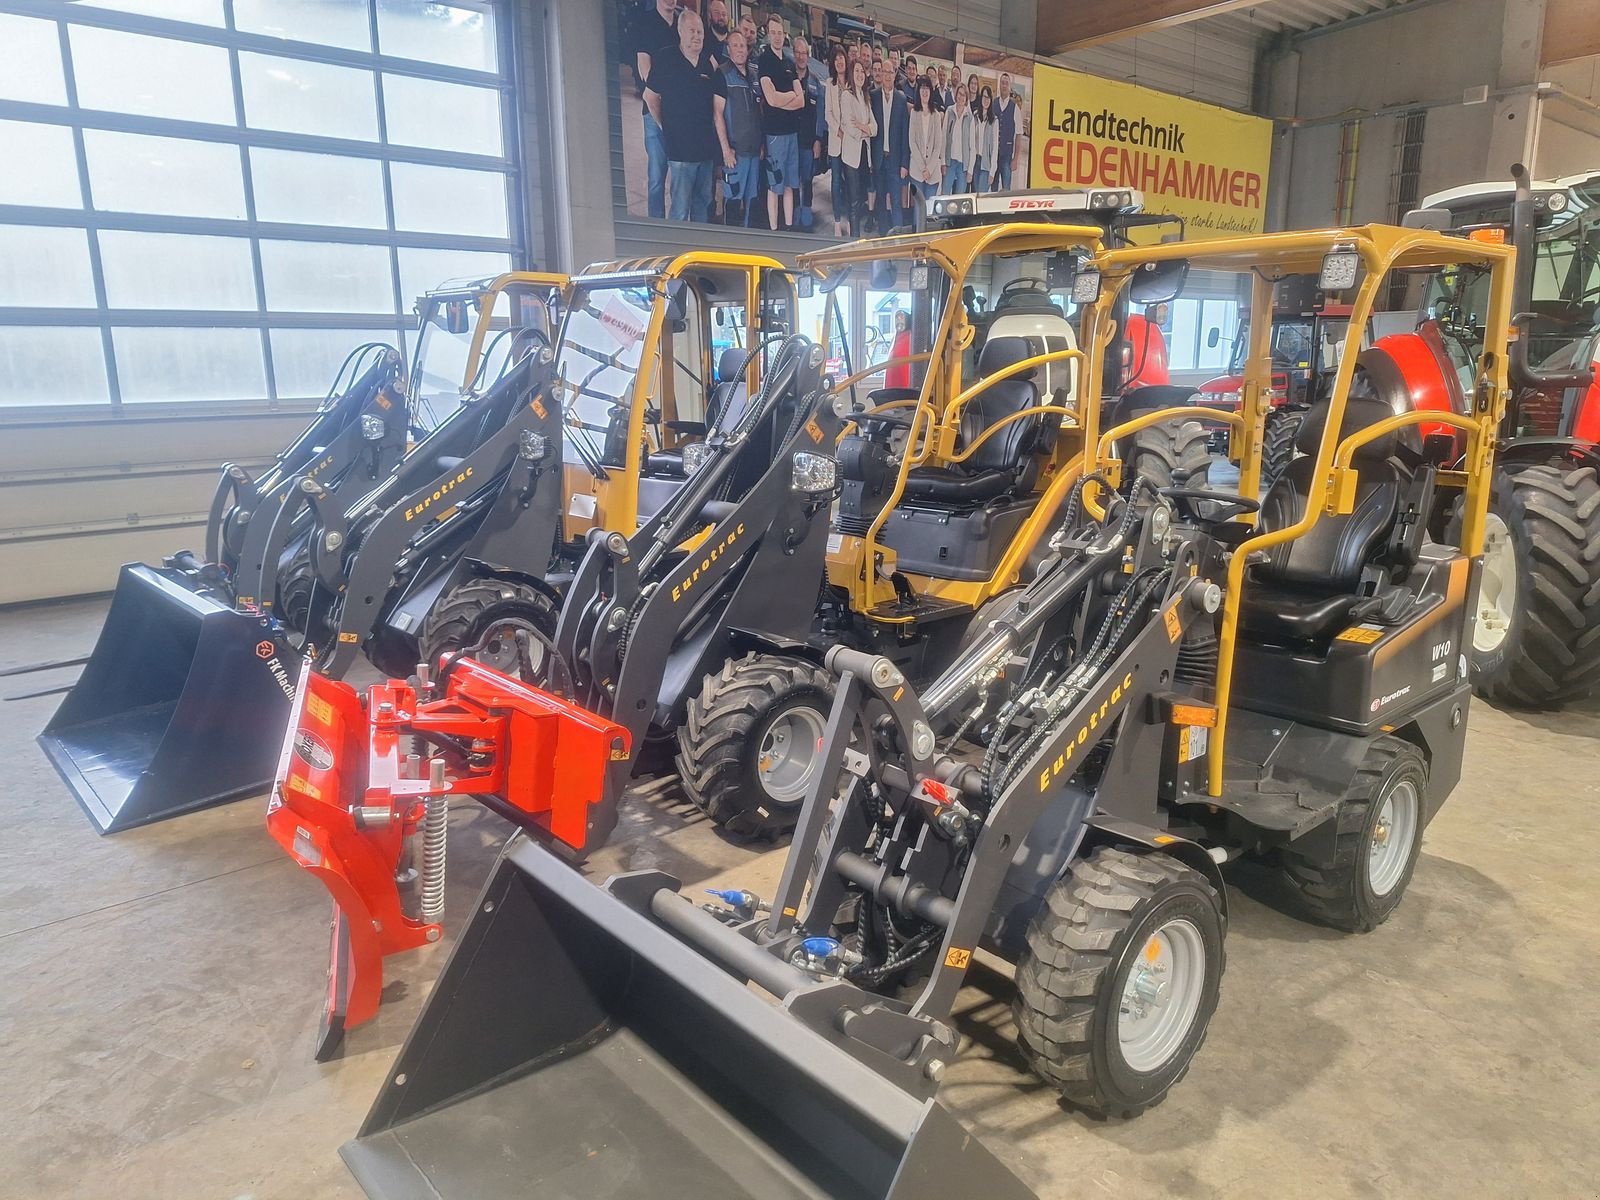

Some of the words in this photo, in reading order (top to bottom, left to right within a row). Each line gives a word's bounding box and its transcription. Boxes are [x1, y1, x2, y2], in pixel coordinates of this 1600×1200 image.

[1048, 99, 1185, 153] Landtechnik
[1043, 138, 1261, 209] EIDENHAMMER
[1009, 199, 1056, 209] STEYR
[404, 465, 475, 522] Eurotrac
[671, 521, 746, 602] Eurotrac
[267, 657, 282, 673] FK
[1432, 640, 1451, 662] W10
[1381, 685, 1411, 706] Eurotrac
[1039, 672, 1135, 792] Eurotrac
